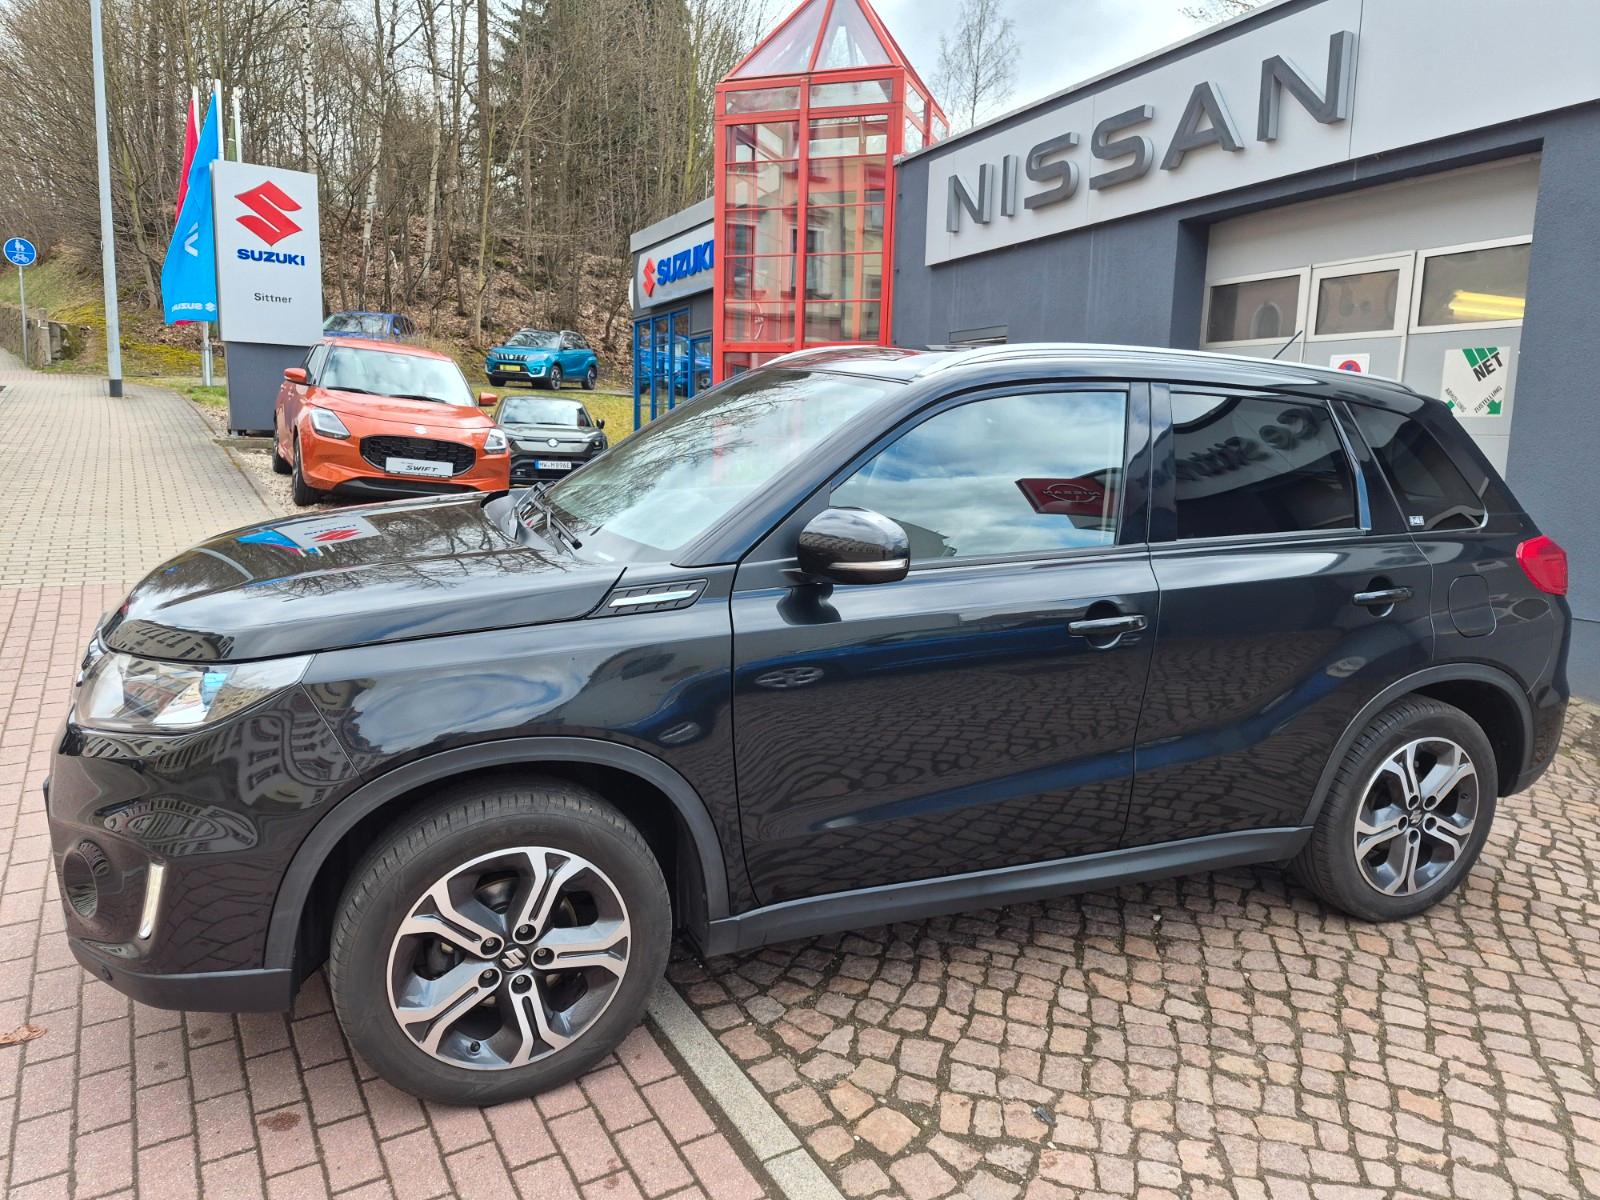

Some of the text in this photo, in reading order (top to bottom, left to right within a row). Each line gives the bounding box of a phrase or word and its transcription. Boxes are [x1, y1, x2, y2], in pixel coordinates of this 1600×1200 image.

[946, 30, 1354, 233] NISSAN
[237, 248, 305, 266] SUZUKI
[657, 240, 714, 286] SUZUKI
[254, 292, 292, 304] Sittner
[1472, 351, 1503, 382] NET
